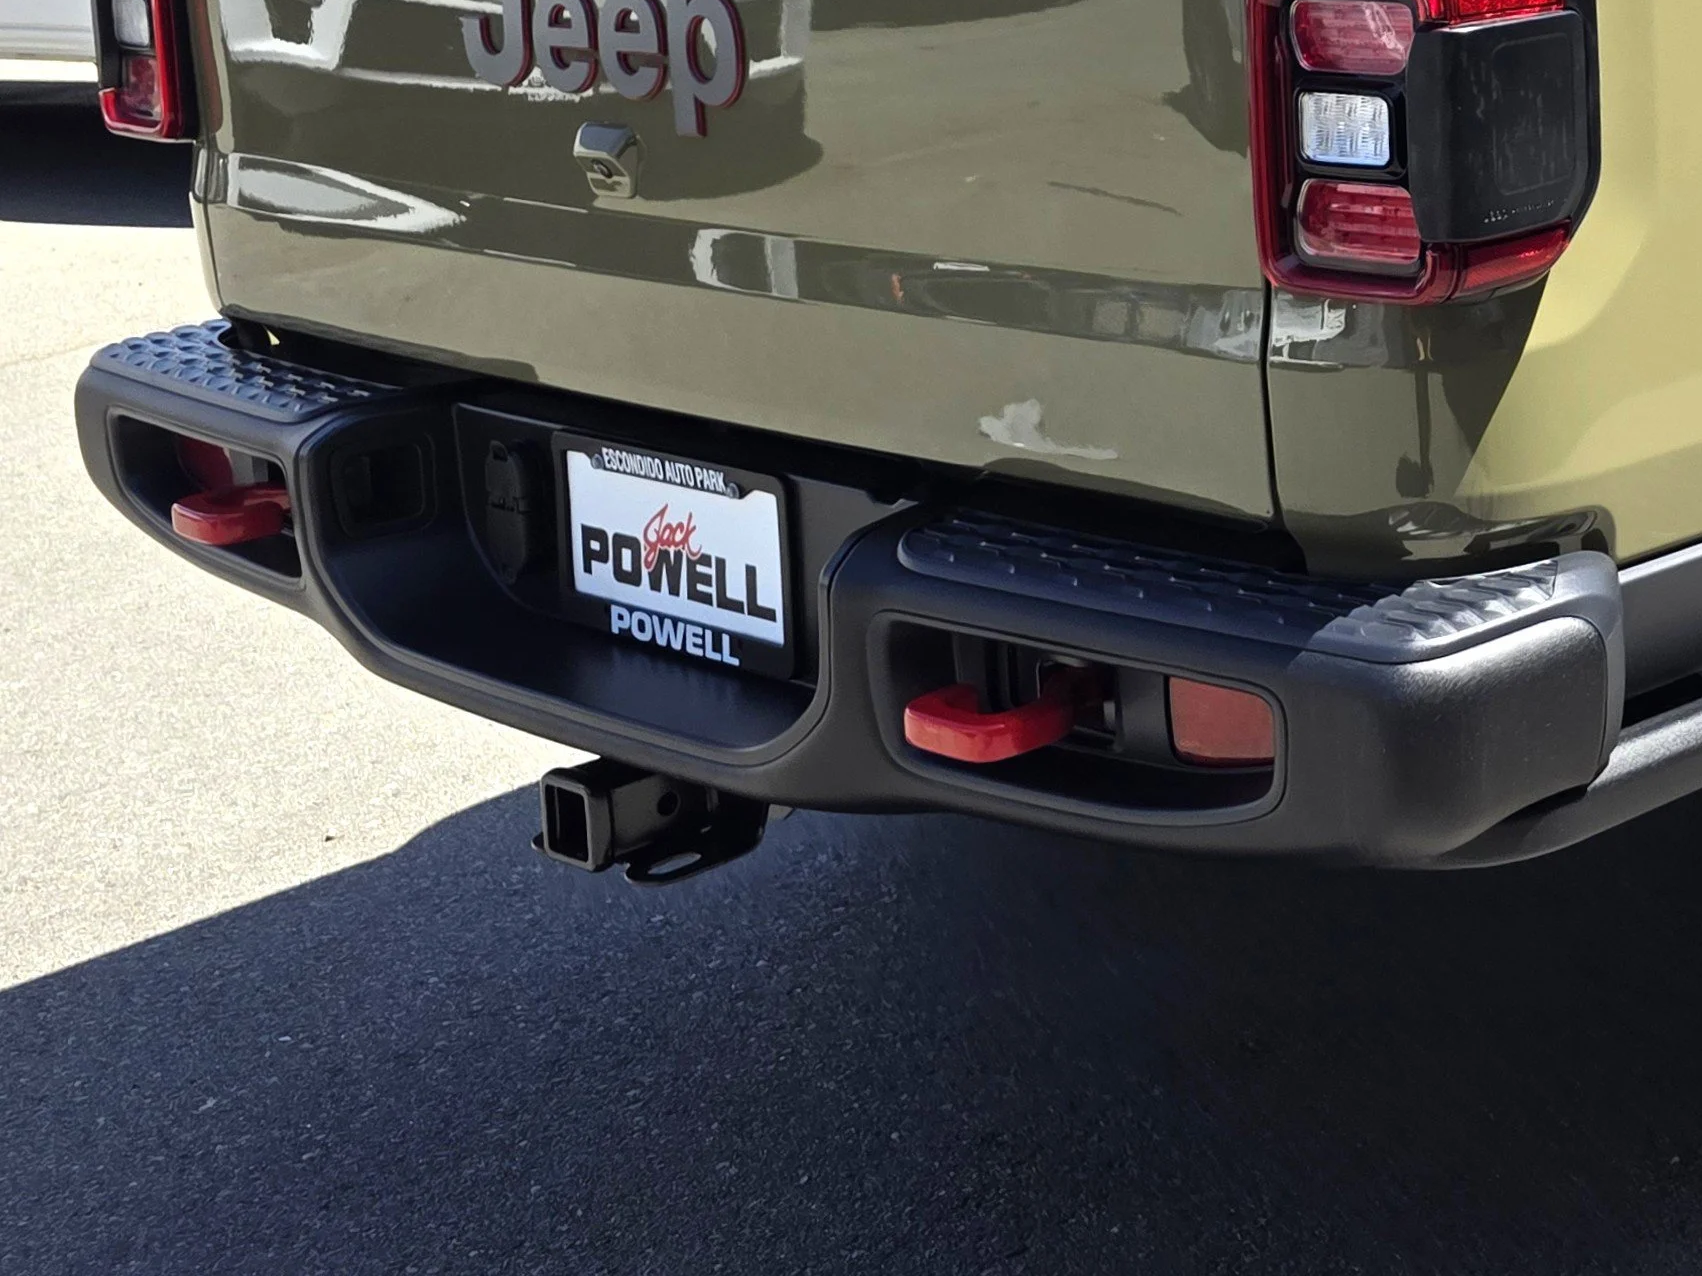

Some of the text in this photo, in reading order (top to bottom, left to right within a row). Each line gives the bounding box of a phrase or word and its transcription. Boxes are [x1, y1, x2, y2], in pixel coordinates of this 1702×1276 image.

[602, 447, 726, 494] ESCONDIDO AUTO PARK
[644, 503, 701, 570] Jack
[581, 523, 777, 623] POWELL
[610, 604, 740, 666] POWELL
